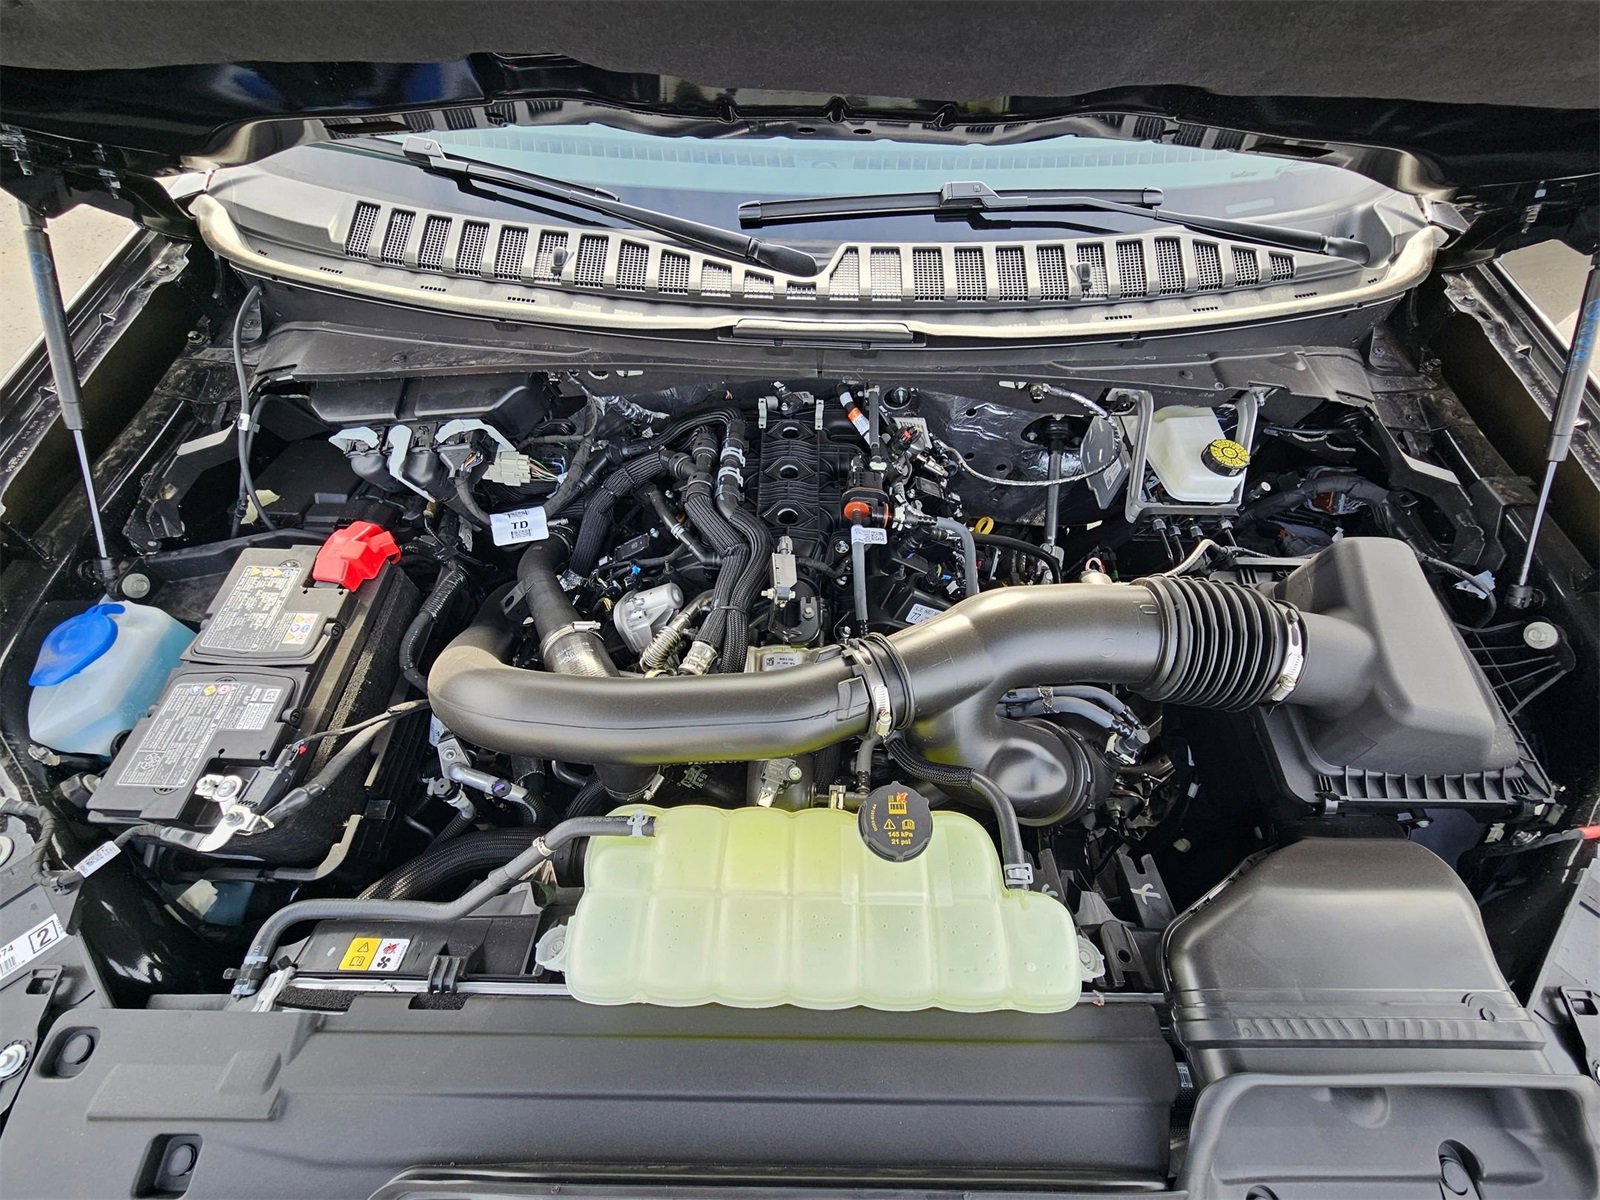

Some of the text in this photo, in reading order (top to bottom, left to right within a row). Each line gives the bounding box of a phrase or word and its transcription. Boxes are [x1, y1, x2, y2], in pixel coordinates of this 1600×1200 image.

[511, 520, 529, 530] TD
[901, 838, 911, 846] psi
[36, 927, 52, 947] 2
[0, 944, 14, 959] 74
